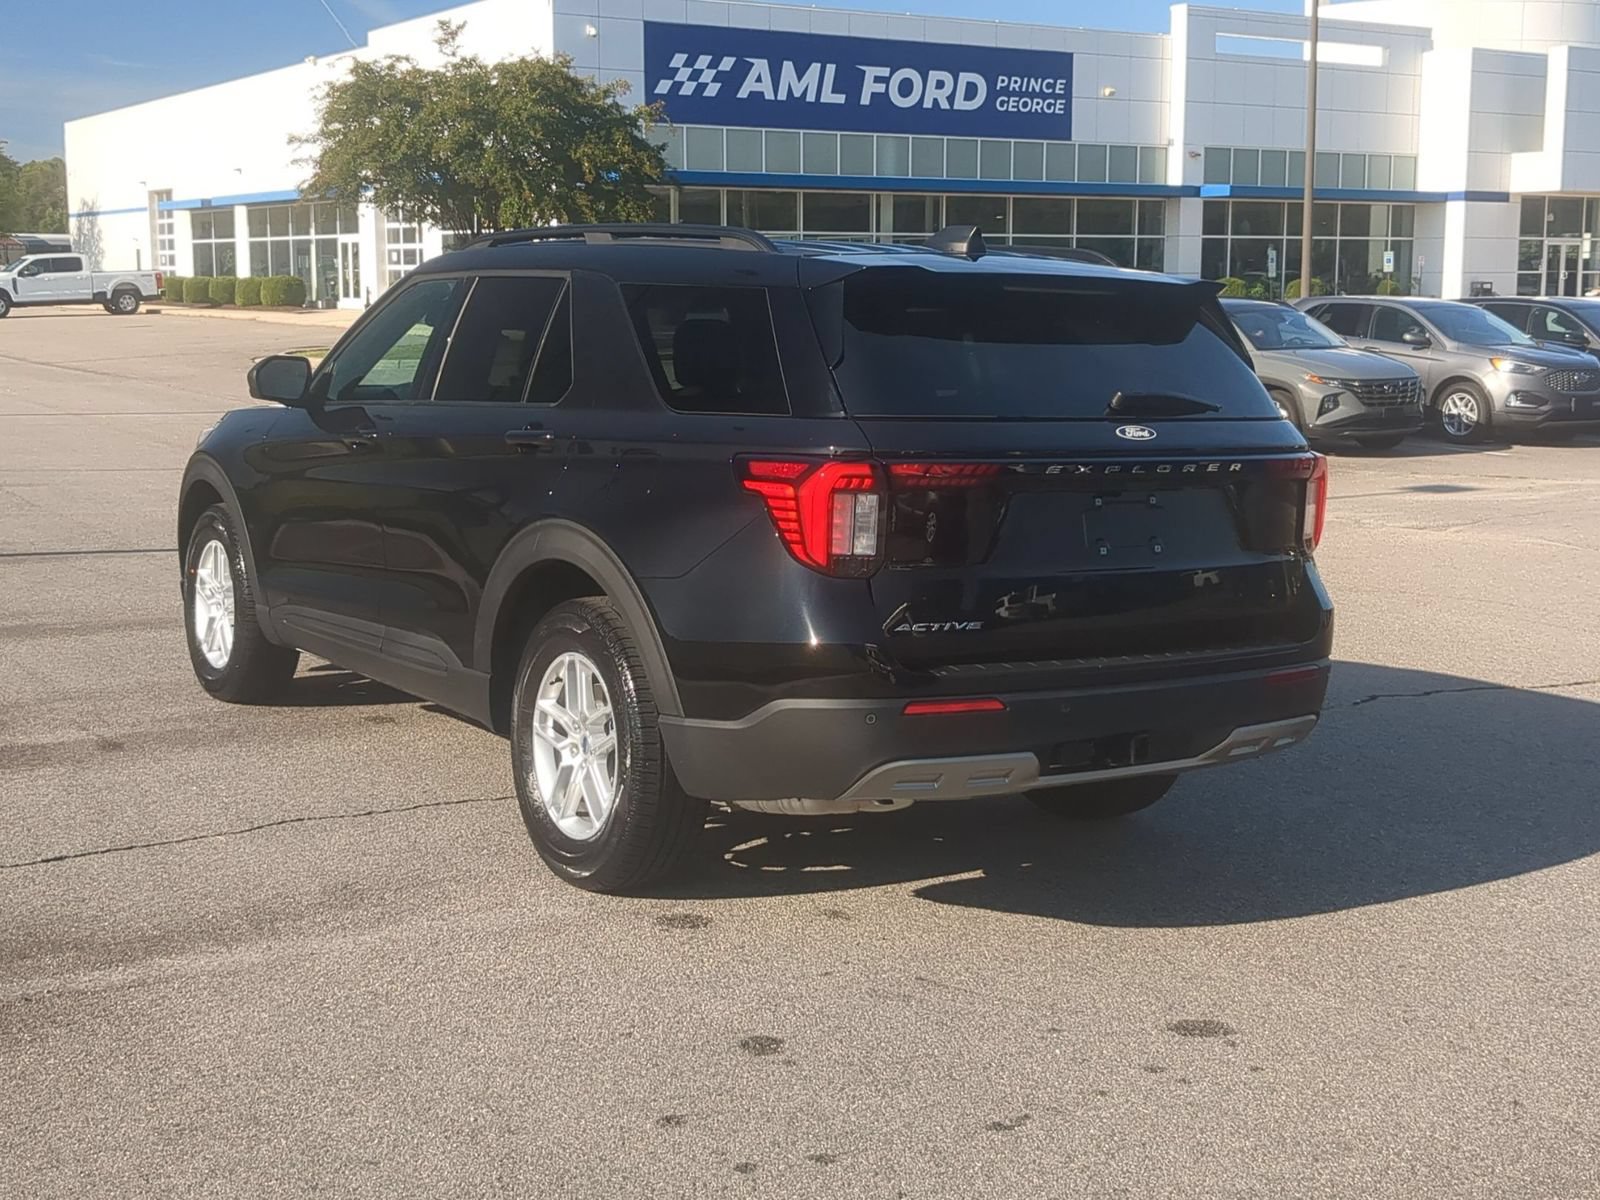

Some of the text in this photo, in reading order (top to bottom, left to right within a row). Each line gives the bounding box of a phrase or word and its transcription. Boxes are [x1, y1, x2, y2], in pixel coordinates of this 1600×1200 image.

[736, 58, 987, 111] AML FORD
[996, 76, 1067, 94] PRINCE
[995, 96, 1067, 114] GEORGE
[1045, 463, 1242, 474] EXPLORER
[894, 620, 985, 632] ACTIVE
